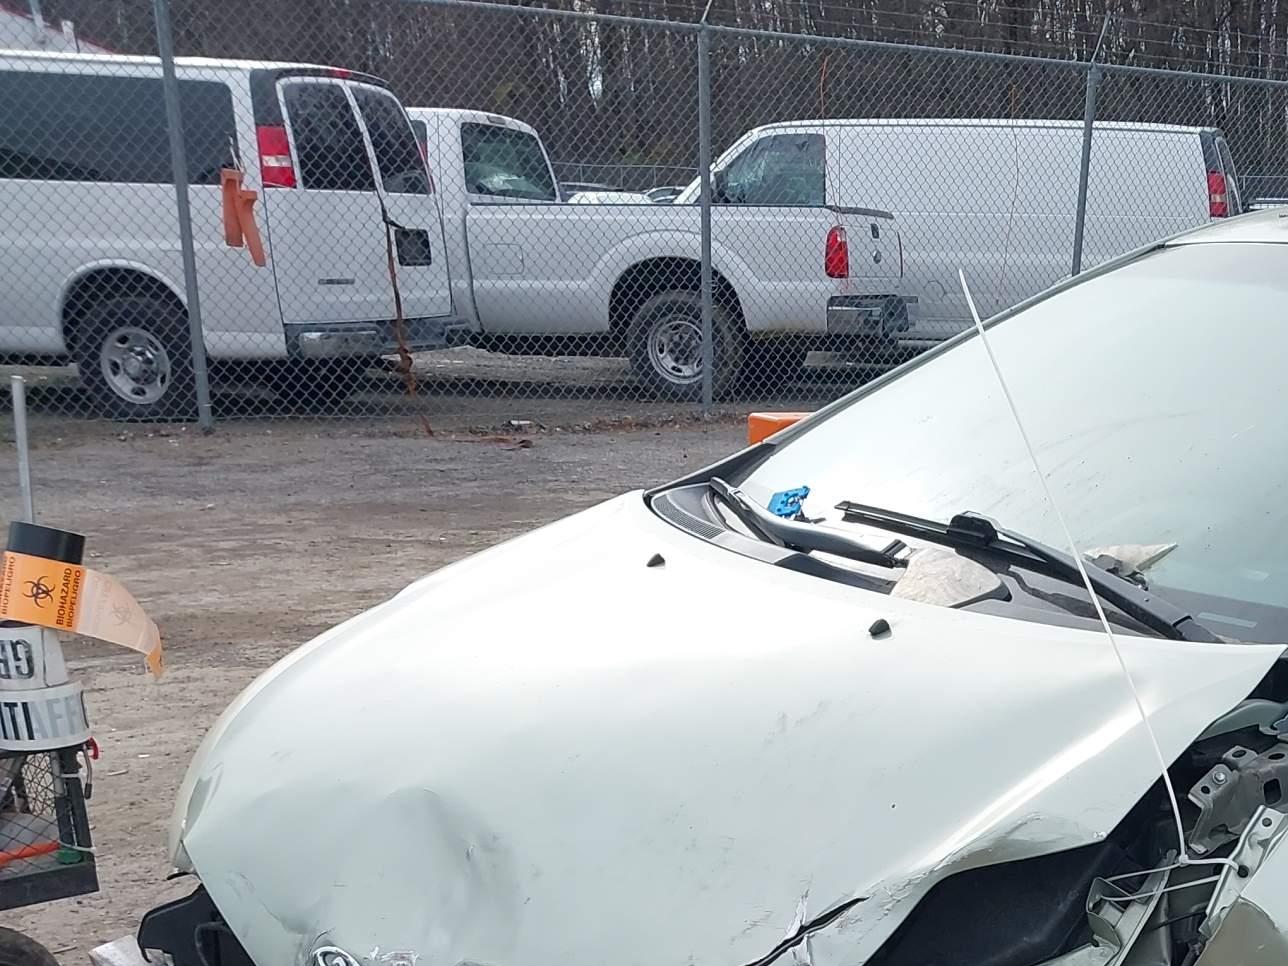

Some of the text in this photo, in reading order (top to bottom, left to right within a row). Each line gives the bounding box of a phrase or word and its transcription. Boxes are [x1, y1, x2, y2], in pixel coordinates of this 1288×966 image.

[1, 556, 16, 615] BIOPELIGRO
[56, 568, 72, 625] BIOHAZARD
[66, 570, 81, 628] BIOPELIGRO
